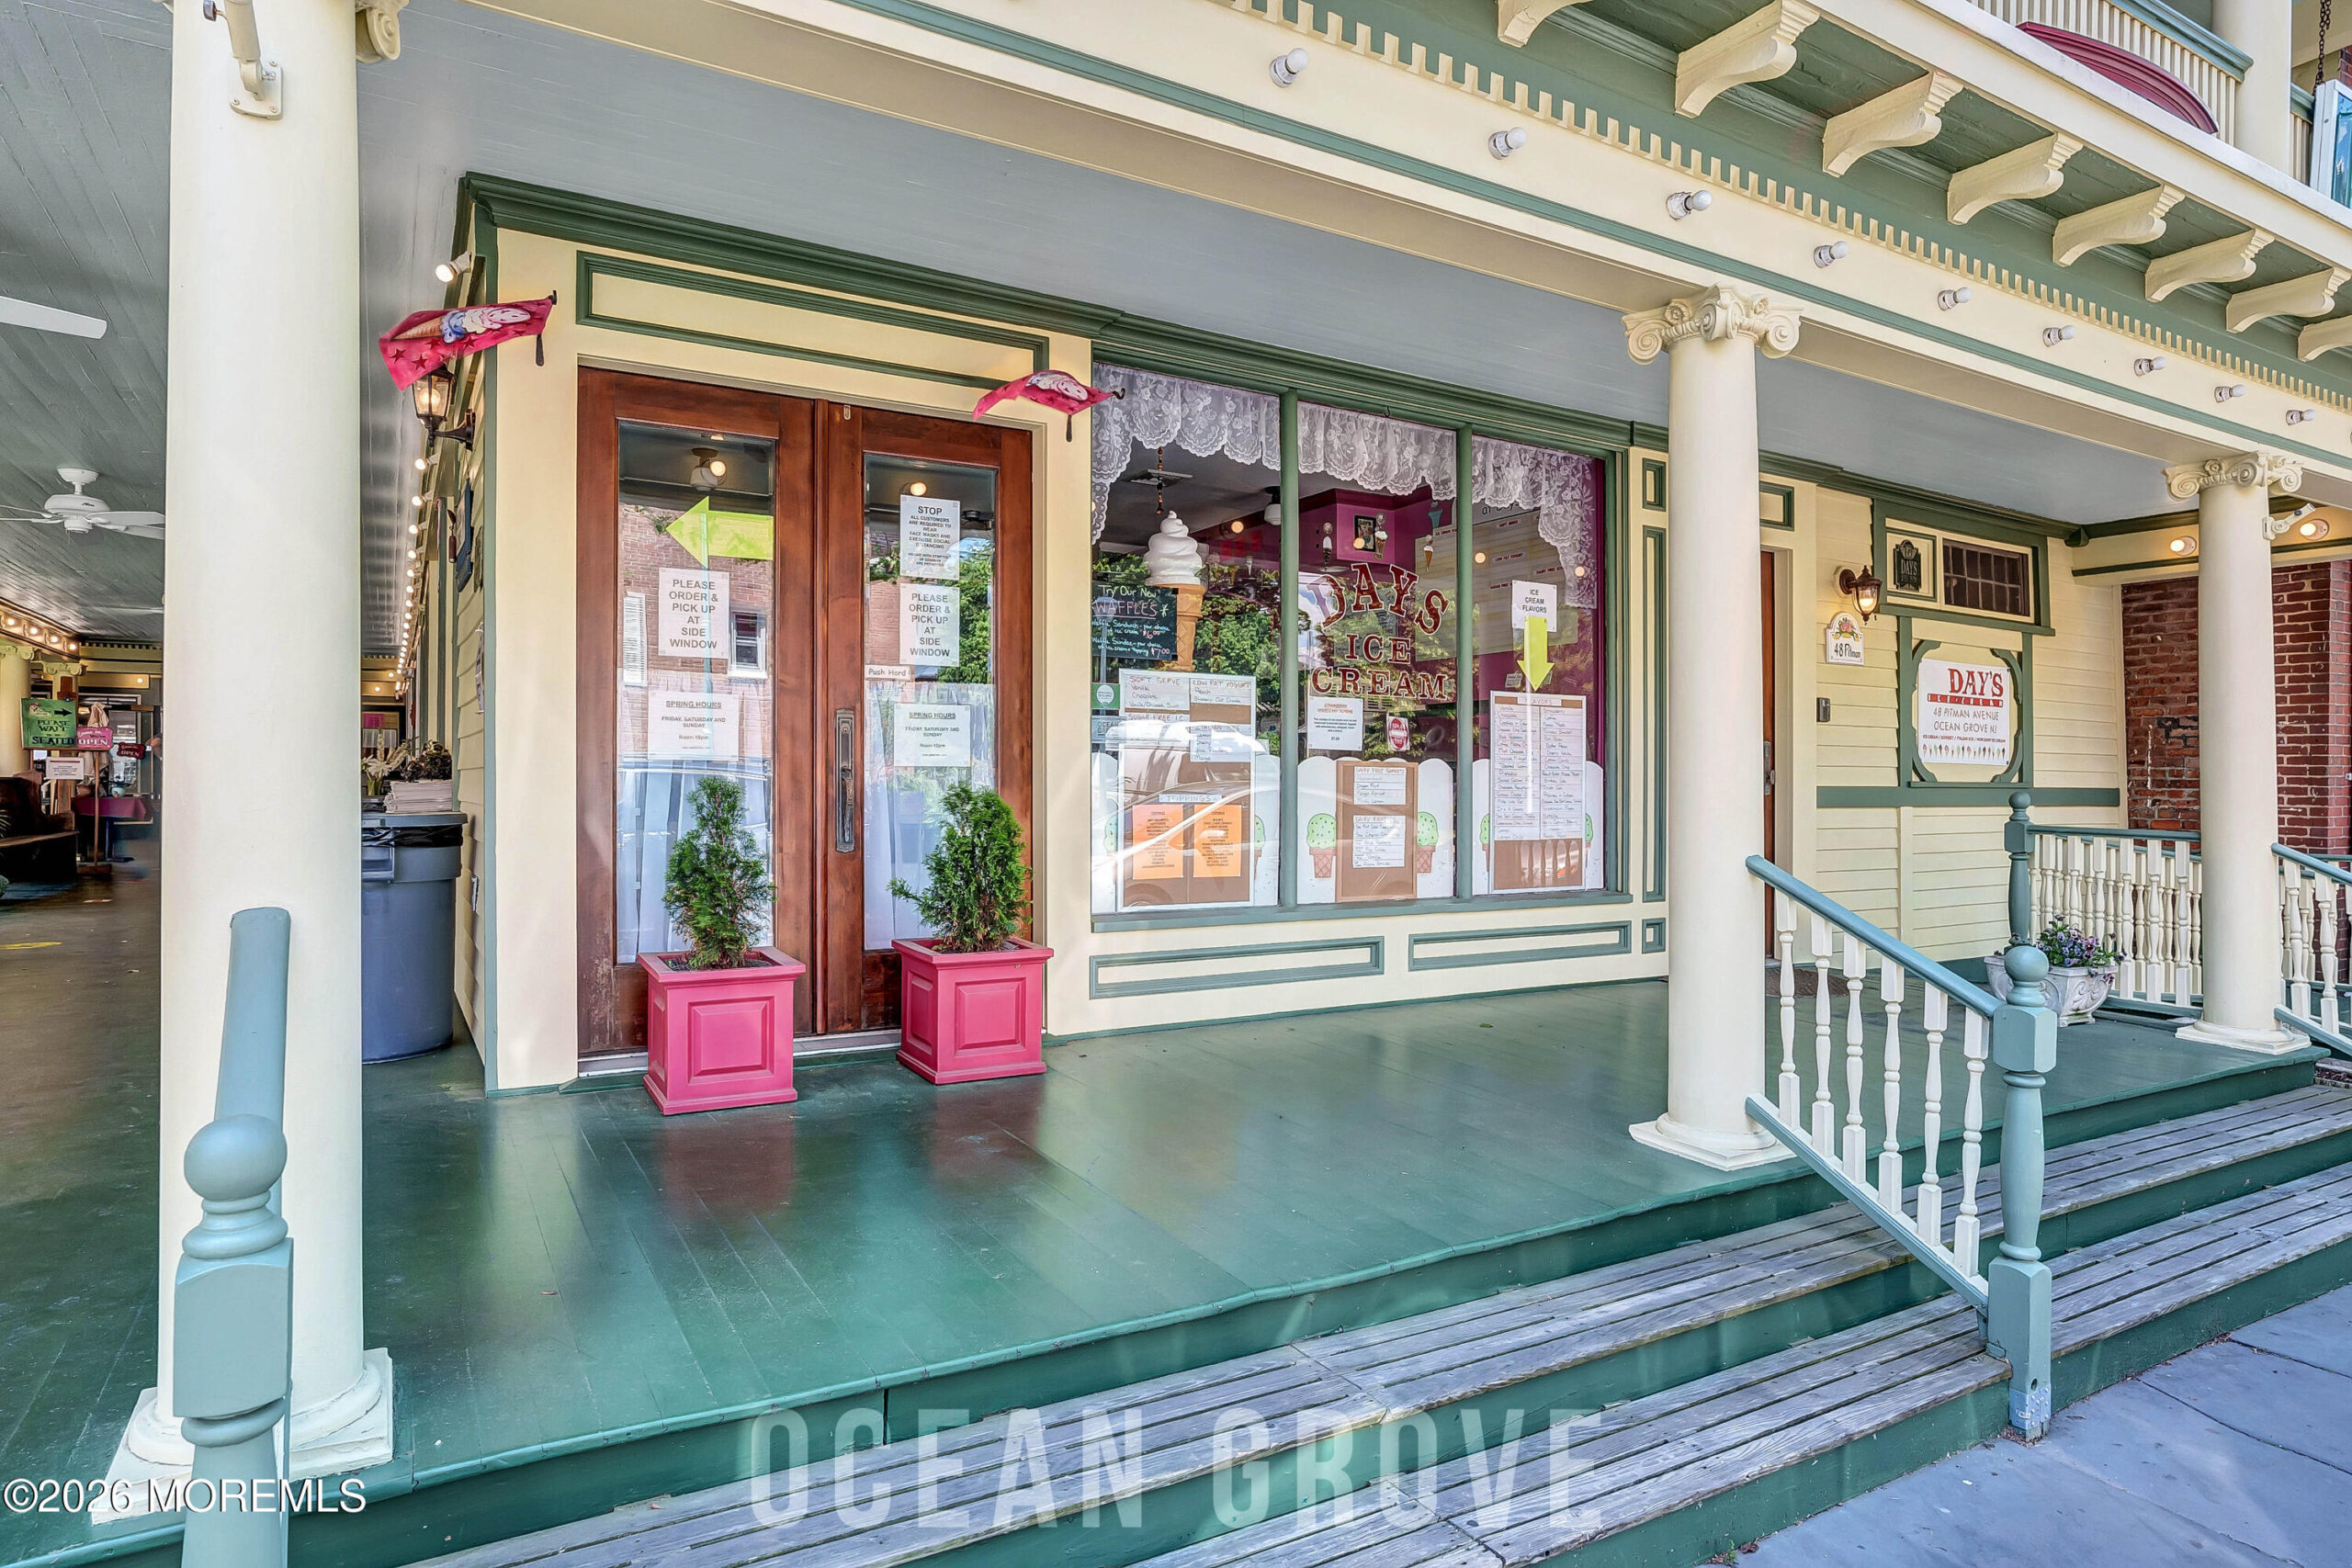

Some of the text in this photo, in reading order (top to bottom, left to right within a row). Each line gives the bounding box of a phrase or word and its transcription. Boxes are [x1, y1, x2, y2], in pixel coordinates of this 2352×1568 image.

[917, 505, 943, 514] STOP
[1901, 558, 1917, 576] DAYS
[673, 579, 716, 590] PLEASE
[1098, 584, 1157, 599] Try Our New
[669, 591, 718, 603] ORDER &
[911, 592, 948, 603] PLEASE
[1306, 562, 1450, 634] DAYS
[672, 603, 716, 614] PICK UP
[909, 604, 942, 614] ORDER
[1094, 599, 1158, 617] WAFFLES
[1521, 604, 1547, 613] FLAVORS
[686, 615, 701, 625] AT
[911, 615, 948, 625] PICK UP
[681, 627, 707, 637] SIDE
[923, 626, 935, 635] AT
[669, 638, 718, 649] WINDOW
[919, 637, 941, 646] SIDE
[910, 648, 950, 657] WINDOW
[1344, 634, 1411, 664] ICE
[1834, 642, 1844, 657] 48
[1156, 676, 1181, 685] SERVE
[1226, 681, 1250, 689] YOGURT
[1311, 666, 1449, 700] CREAM
[1948, 668, 2004, 697] DAY'S
[665, 700, 722, 709] SPRING HOURS
[1933, 707, 1999, 721] 48 PITMAN AVENUE
[37, 719, 71, 728] PLEASE
[1933, 720, 1997, 734] OCEAN GROVE NJ
[31, 736, 75, 746] SEATED
[120, 750, 141, 758] OPEN
